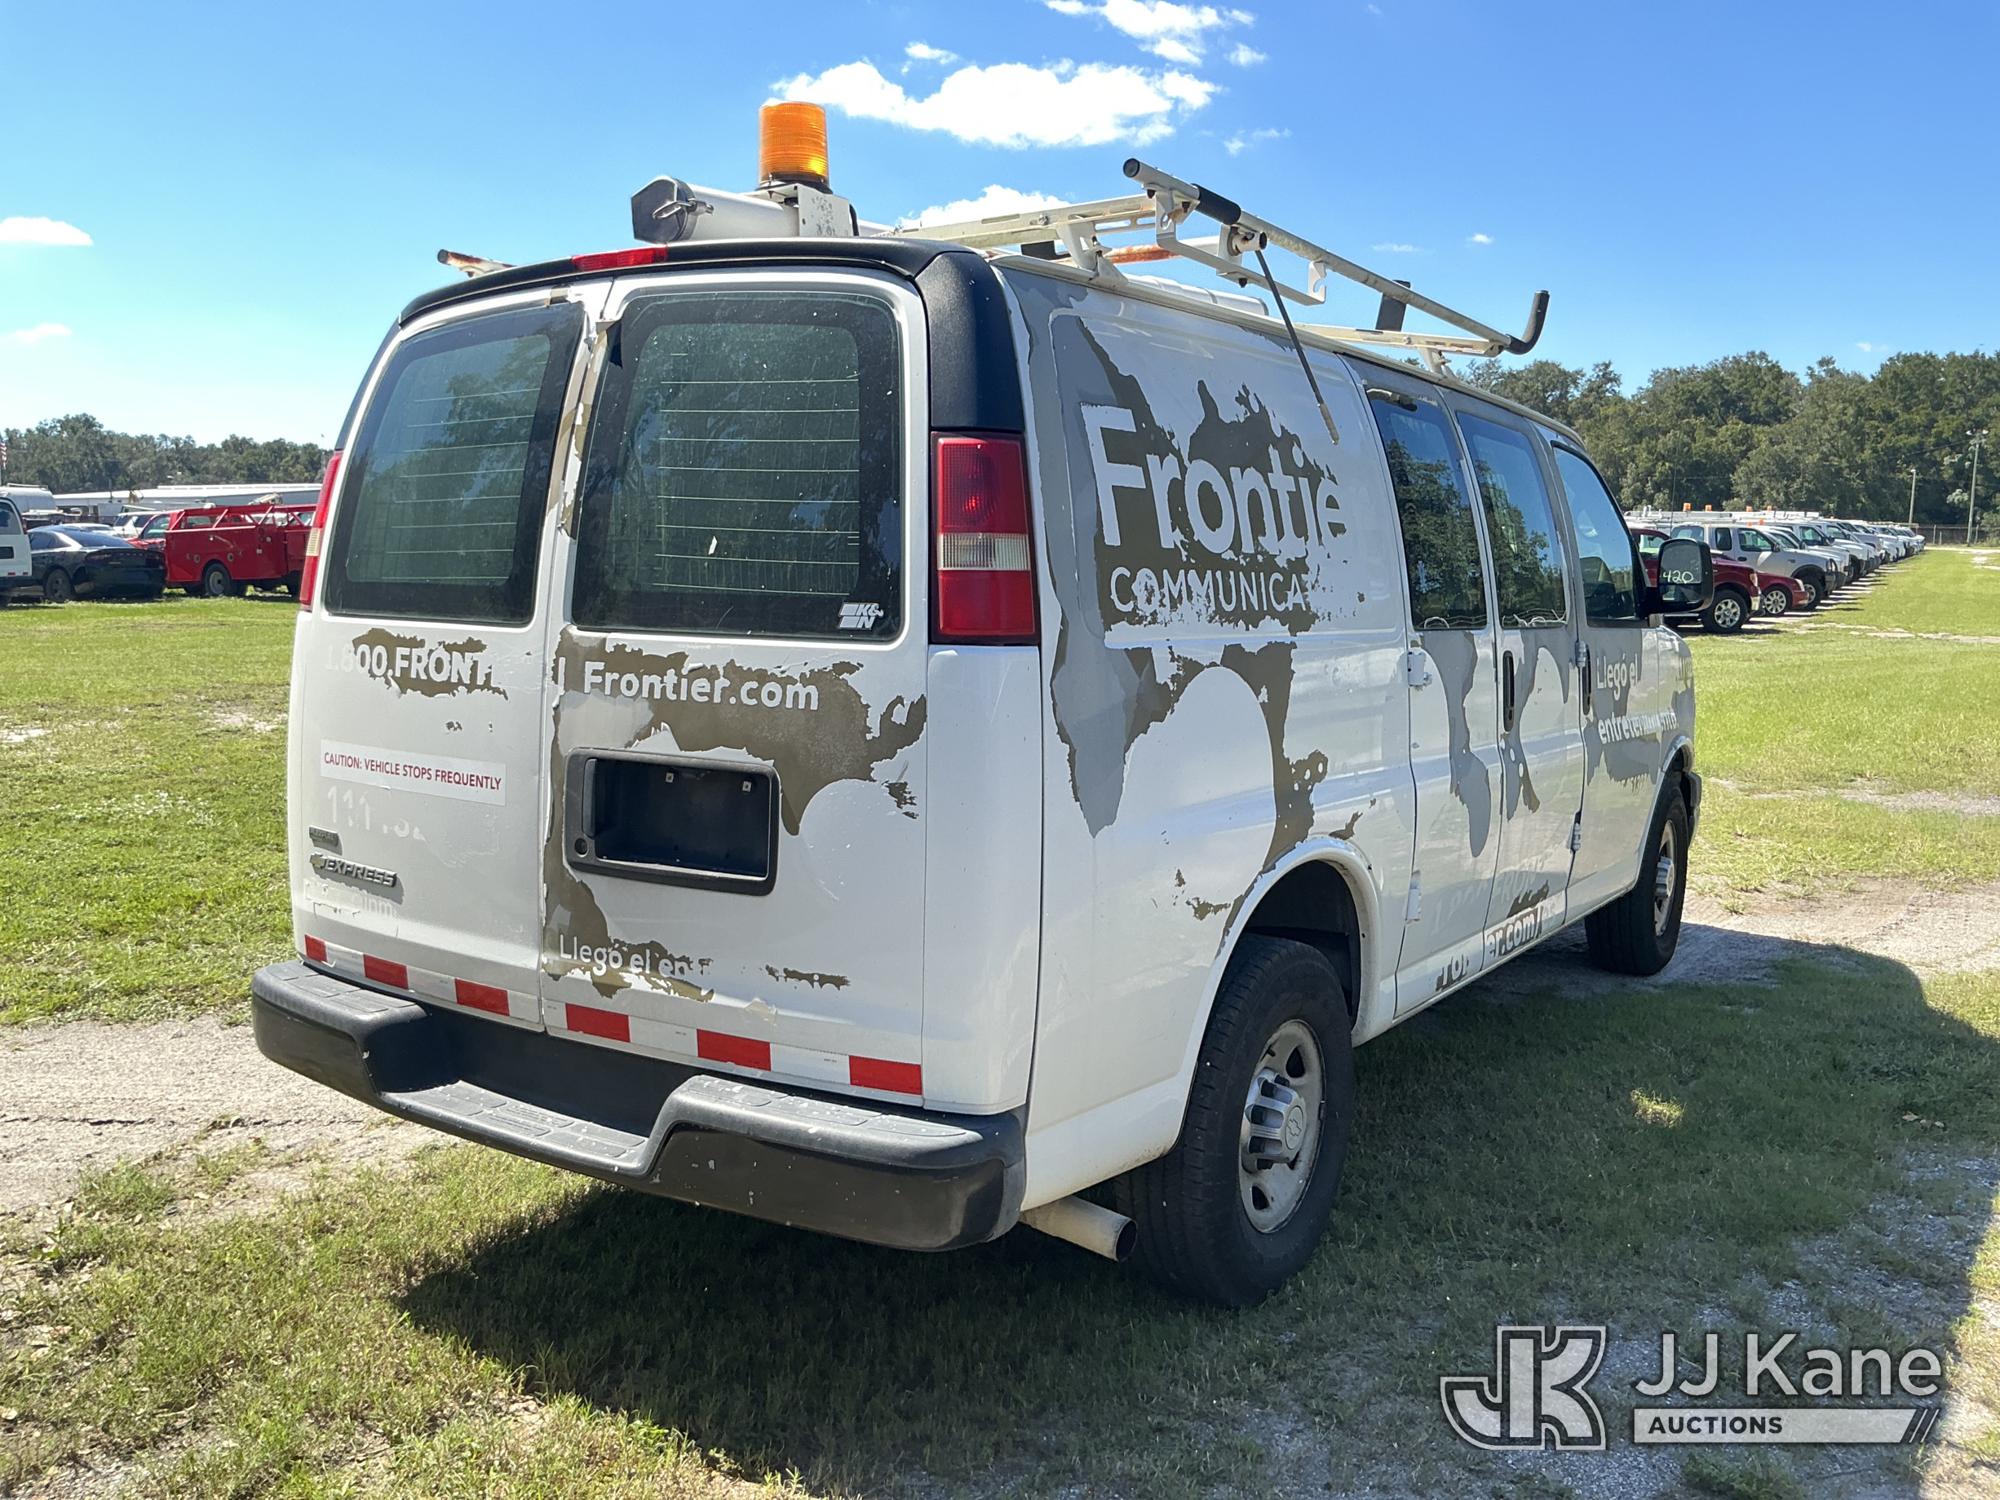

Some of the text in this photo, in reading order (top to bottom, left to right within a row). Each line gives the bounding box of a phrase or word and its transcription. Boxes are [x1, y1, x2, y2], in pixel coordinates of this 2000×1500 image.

[583, 660, 820, 711] Frontier.com
[324, 752, 502, 791] CAUTION: VEHICLE STOPS FREQUENTLY
[324, 857, 398, 888] EXPRESS
[560, 934, 623, 976] Llegó
[630, 949, 651, 974] el
